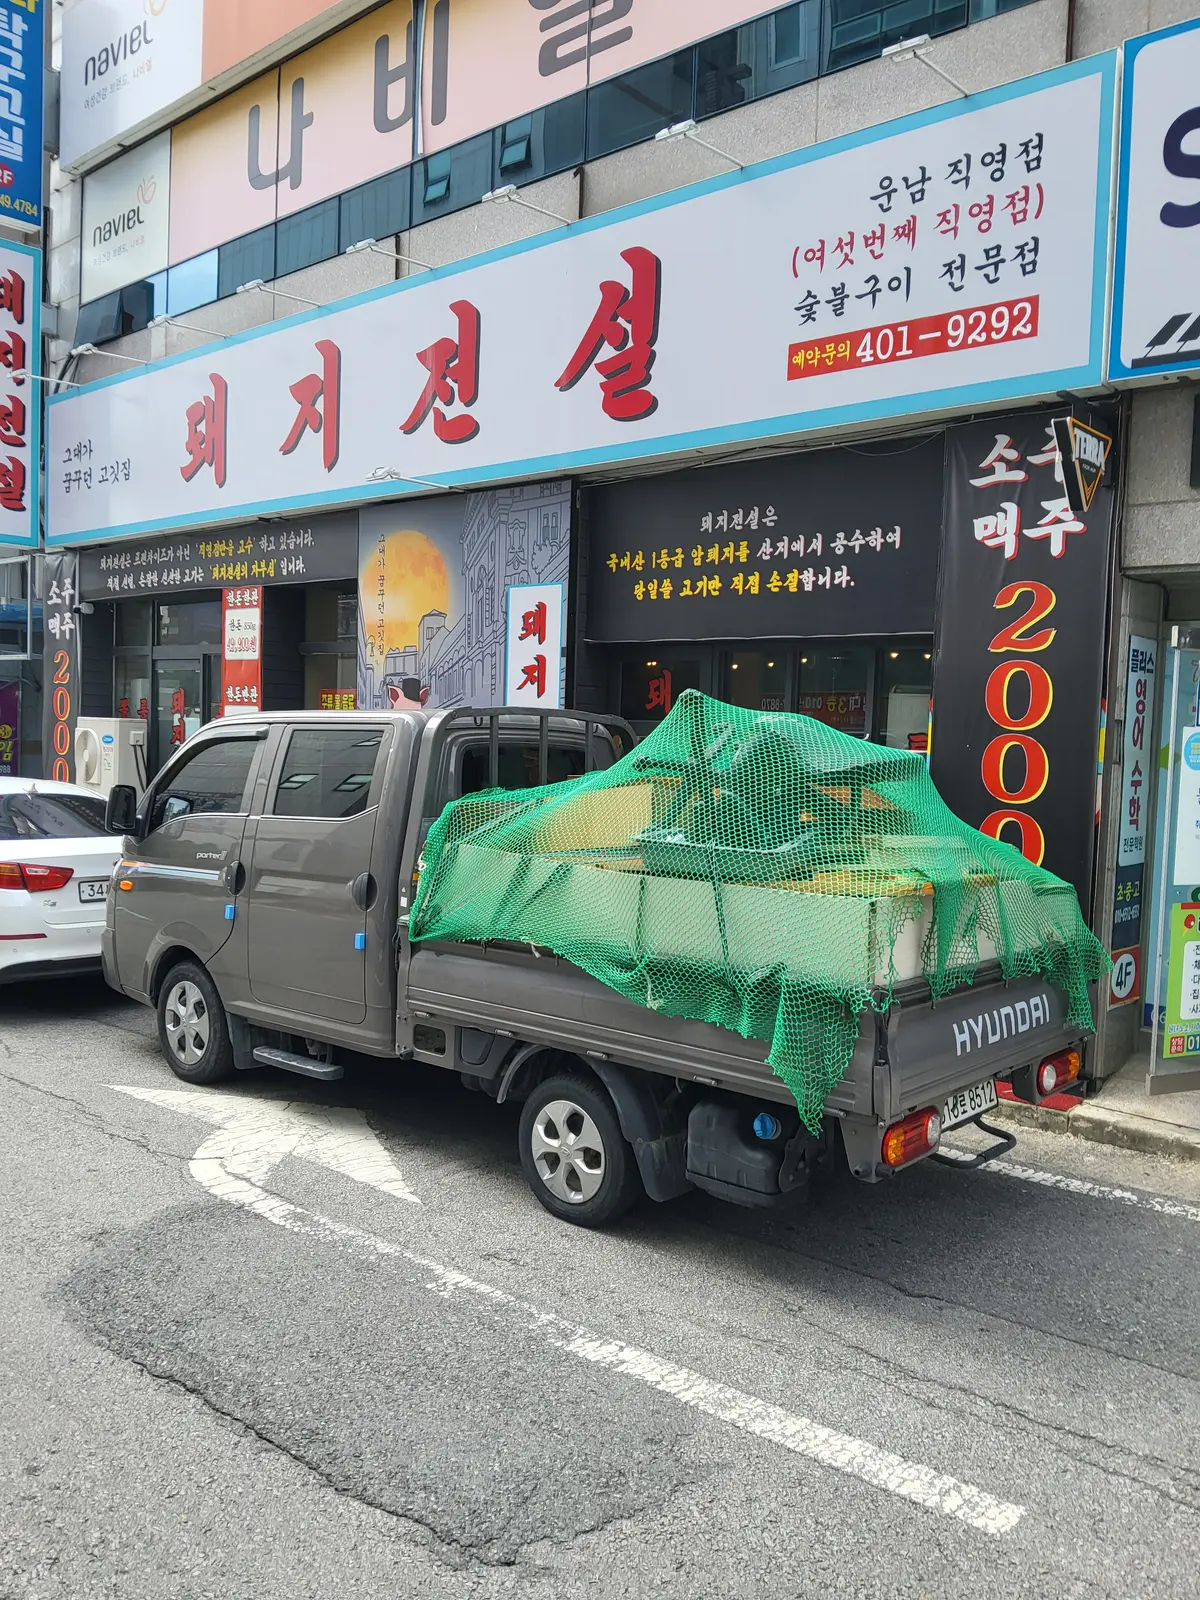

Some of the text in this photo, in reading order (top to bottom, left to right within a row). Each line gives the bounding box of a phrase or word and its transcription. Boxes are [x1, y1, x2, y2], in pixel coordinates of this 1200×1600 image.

[869, 133, 1045, 214] 운남 직영점
[792, 183, 1043, 279] (여섯번째 직영점)
[794, 236, 1041, 326] 숯불구이 전문점
[791, 301, 1033, 371] 예약문의 401-9292
[180, 245, 662, 488] 돼지전설
[62, 439, 93, 463] 그대가
[1073, 427, 1105, 471] TERRA
[62, 456, 131, 493] 꿈꾸던 고깃집
[700, 505, 778, 533] 돼지전설은
[973, 498, 1088, 560] 맥주
[259, 535, 275, 552] 하고
[279, 529, 314, 551] 있습니다.
[605, 551, 645, 573] 국내산
[756, 533, 824, 561] 산지에서
[830, 526, 902, 555] 공수하여
[280, 556, 306, 576] 입니다.
[679, 575, 722, 598] 고기만
[729, 572, 760, 596] 직접
[46, 577, 74, 606] 소주
[48, 612, 75, 640] 맥주
[516, 601, 547, 698] 돼지
[1131, 648, 1154, 674] 플러스
[53, 650, 70, 783] 2000
[1132, 678, 1147, 751] 영어
[1128, 760, 1142, 831] 수학
[1123, 836, 1144, 854] 전문학원
[87, 883, 107, 897] 34
[1115, 961, 1132, 991] 4F
[952, 994, 1050, 1056] HYUNDAI
[969, 1080, 994, 1110] 8512
